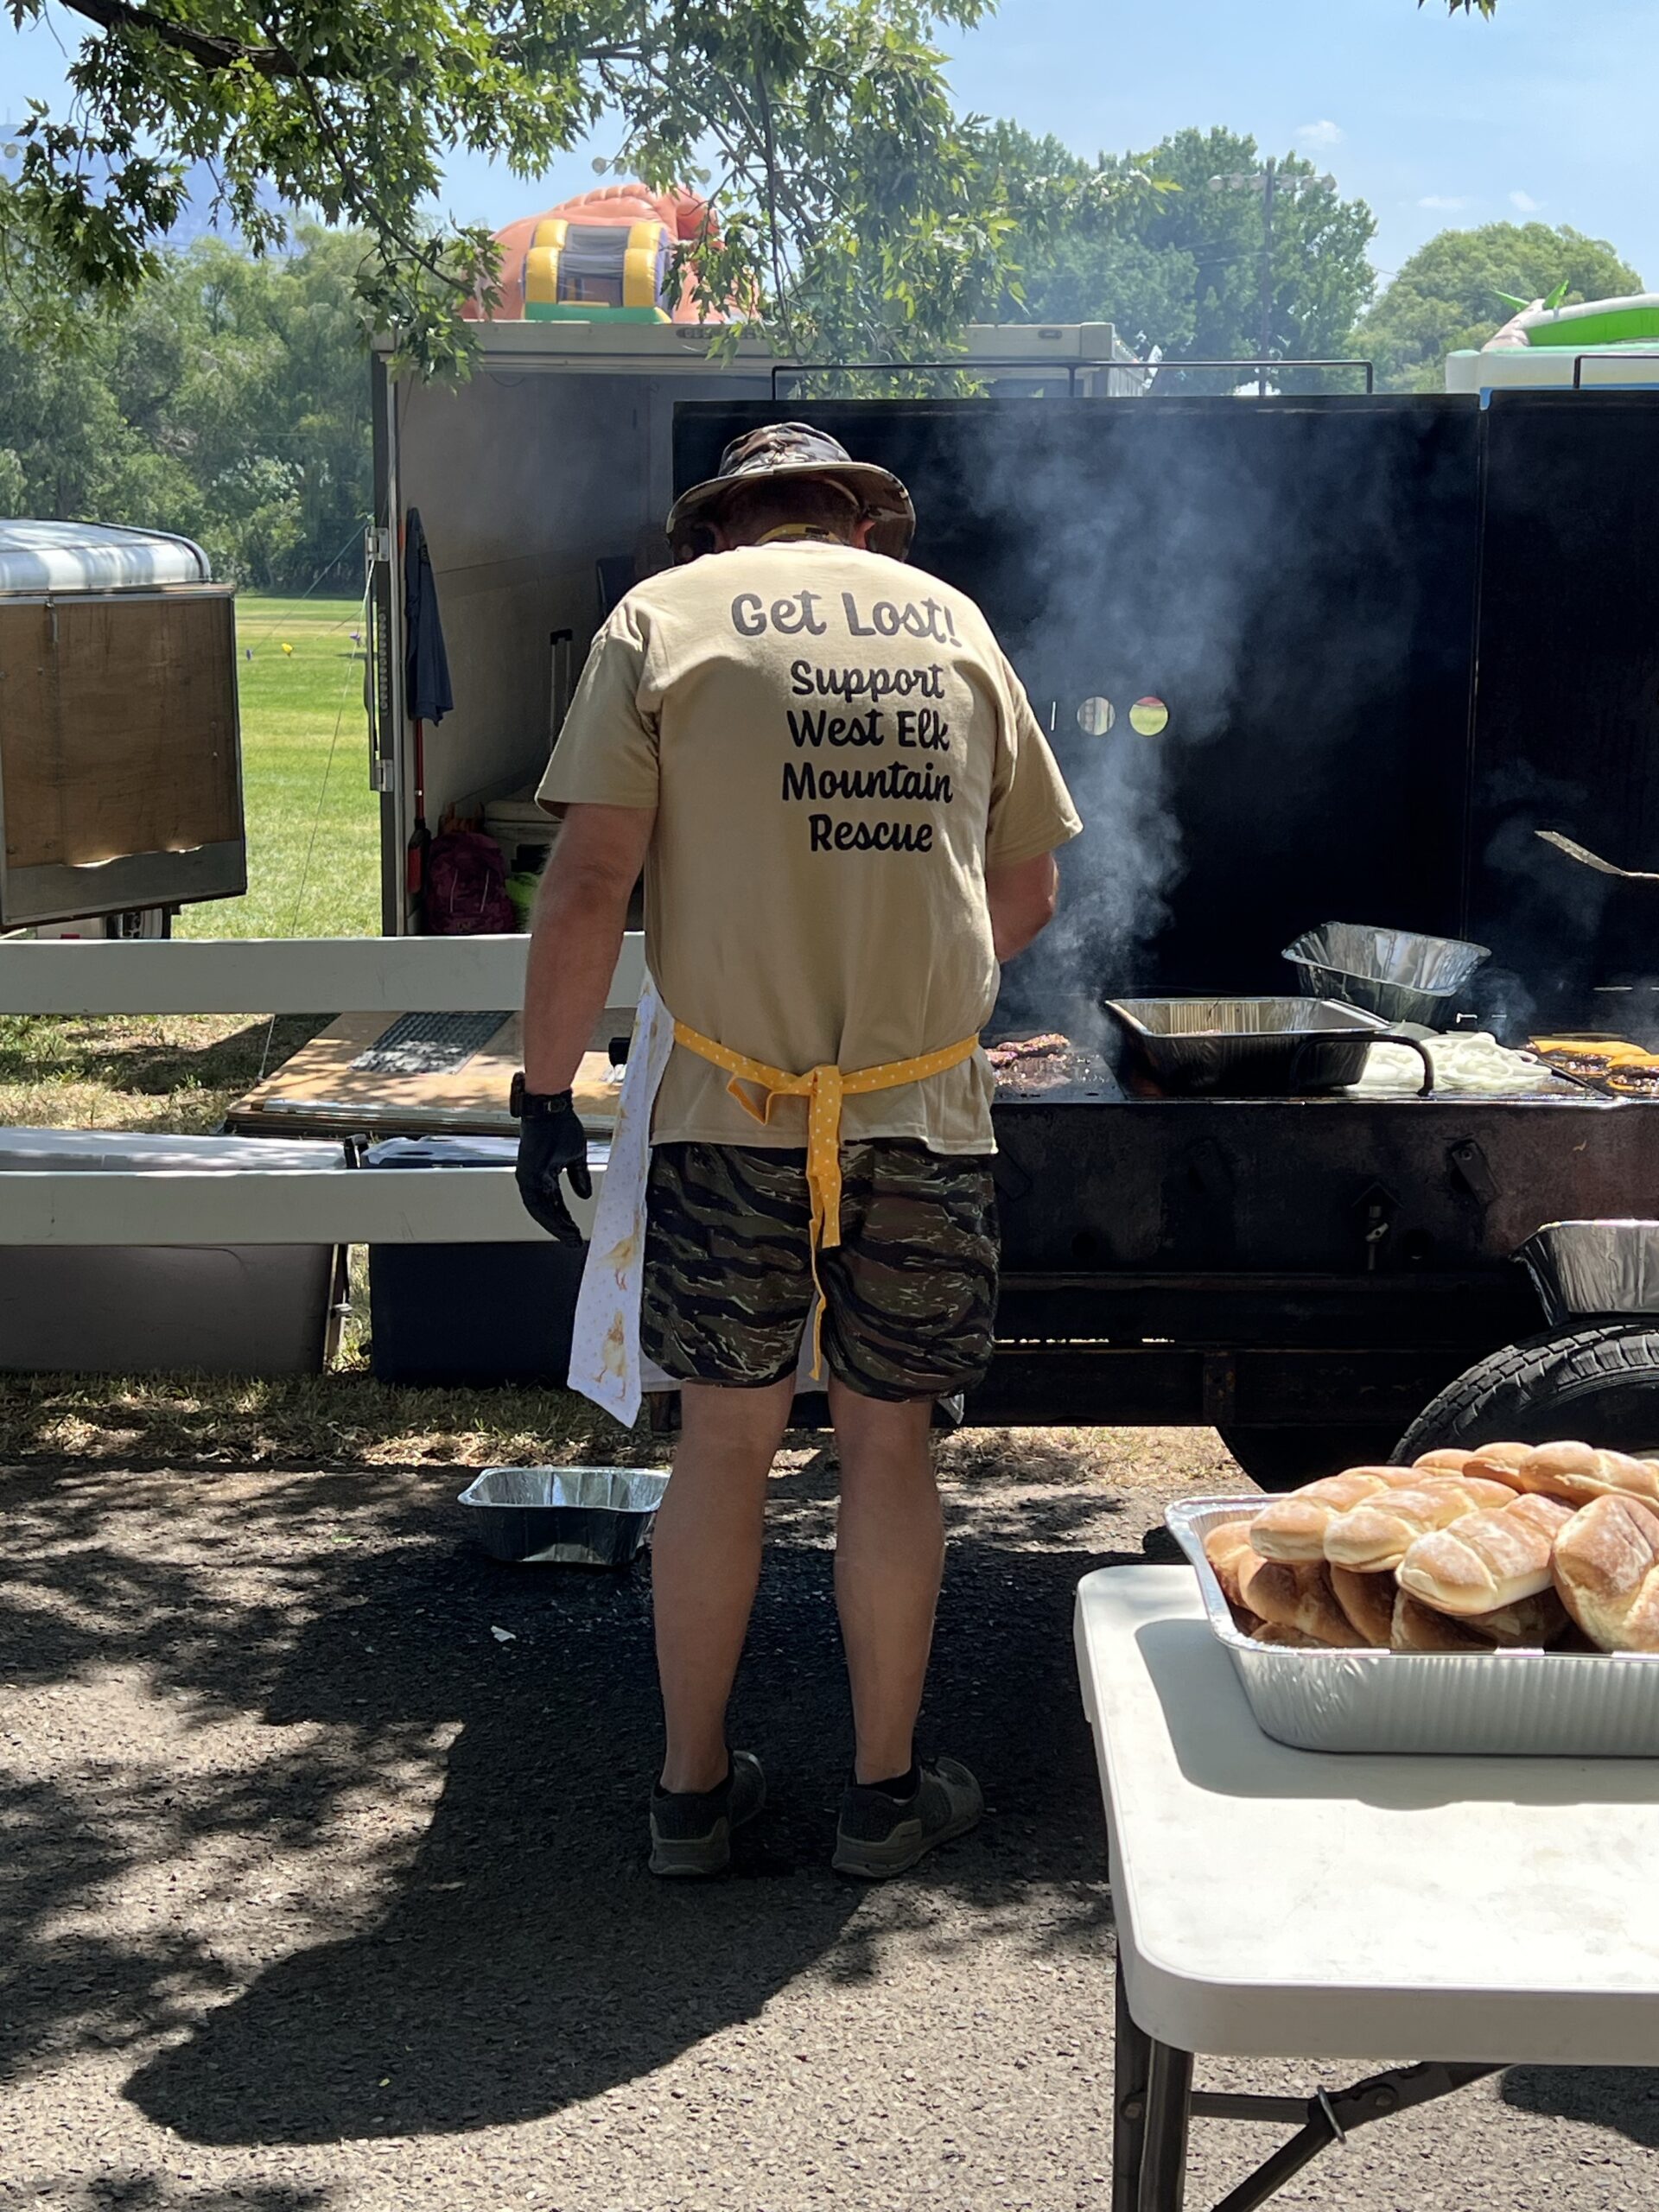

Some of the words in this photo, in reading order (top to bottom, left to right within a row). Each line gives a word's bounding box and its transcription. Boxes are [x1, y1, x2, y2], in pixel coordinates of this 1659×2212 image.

[731, 589, 827, 636] Get
[841, 591, 962, 648] Lost!
[790, 659, 945, 702] Support
[786, 709, 884, 747] West
[897, 708, 950, 751] Elk
[781, 760, 952, 804] Mountain
[808, 813, 933, 852] Rescue
